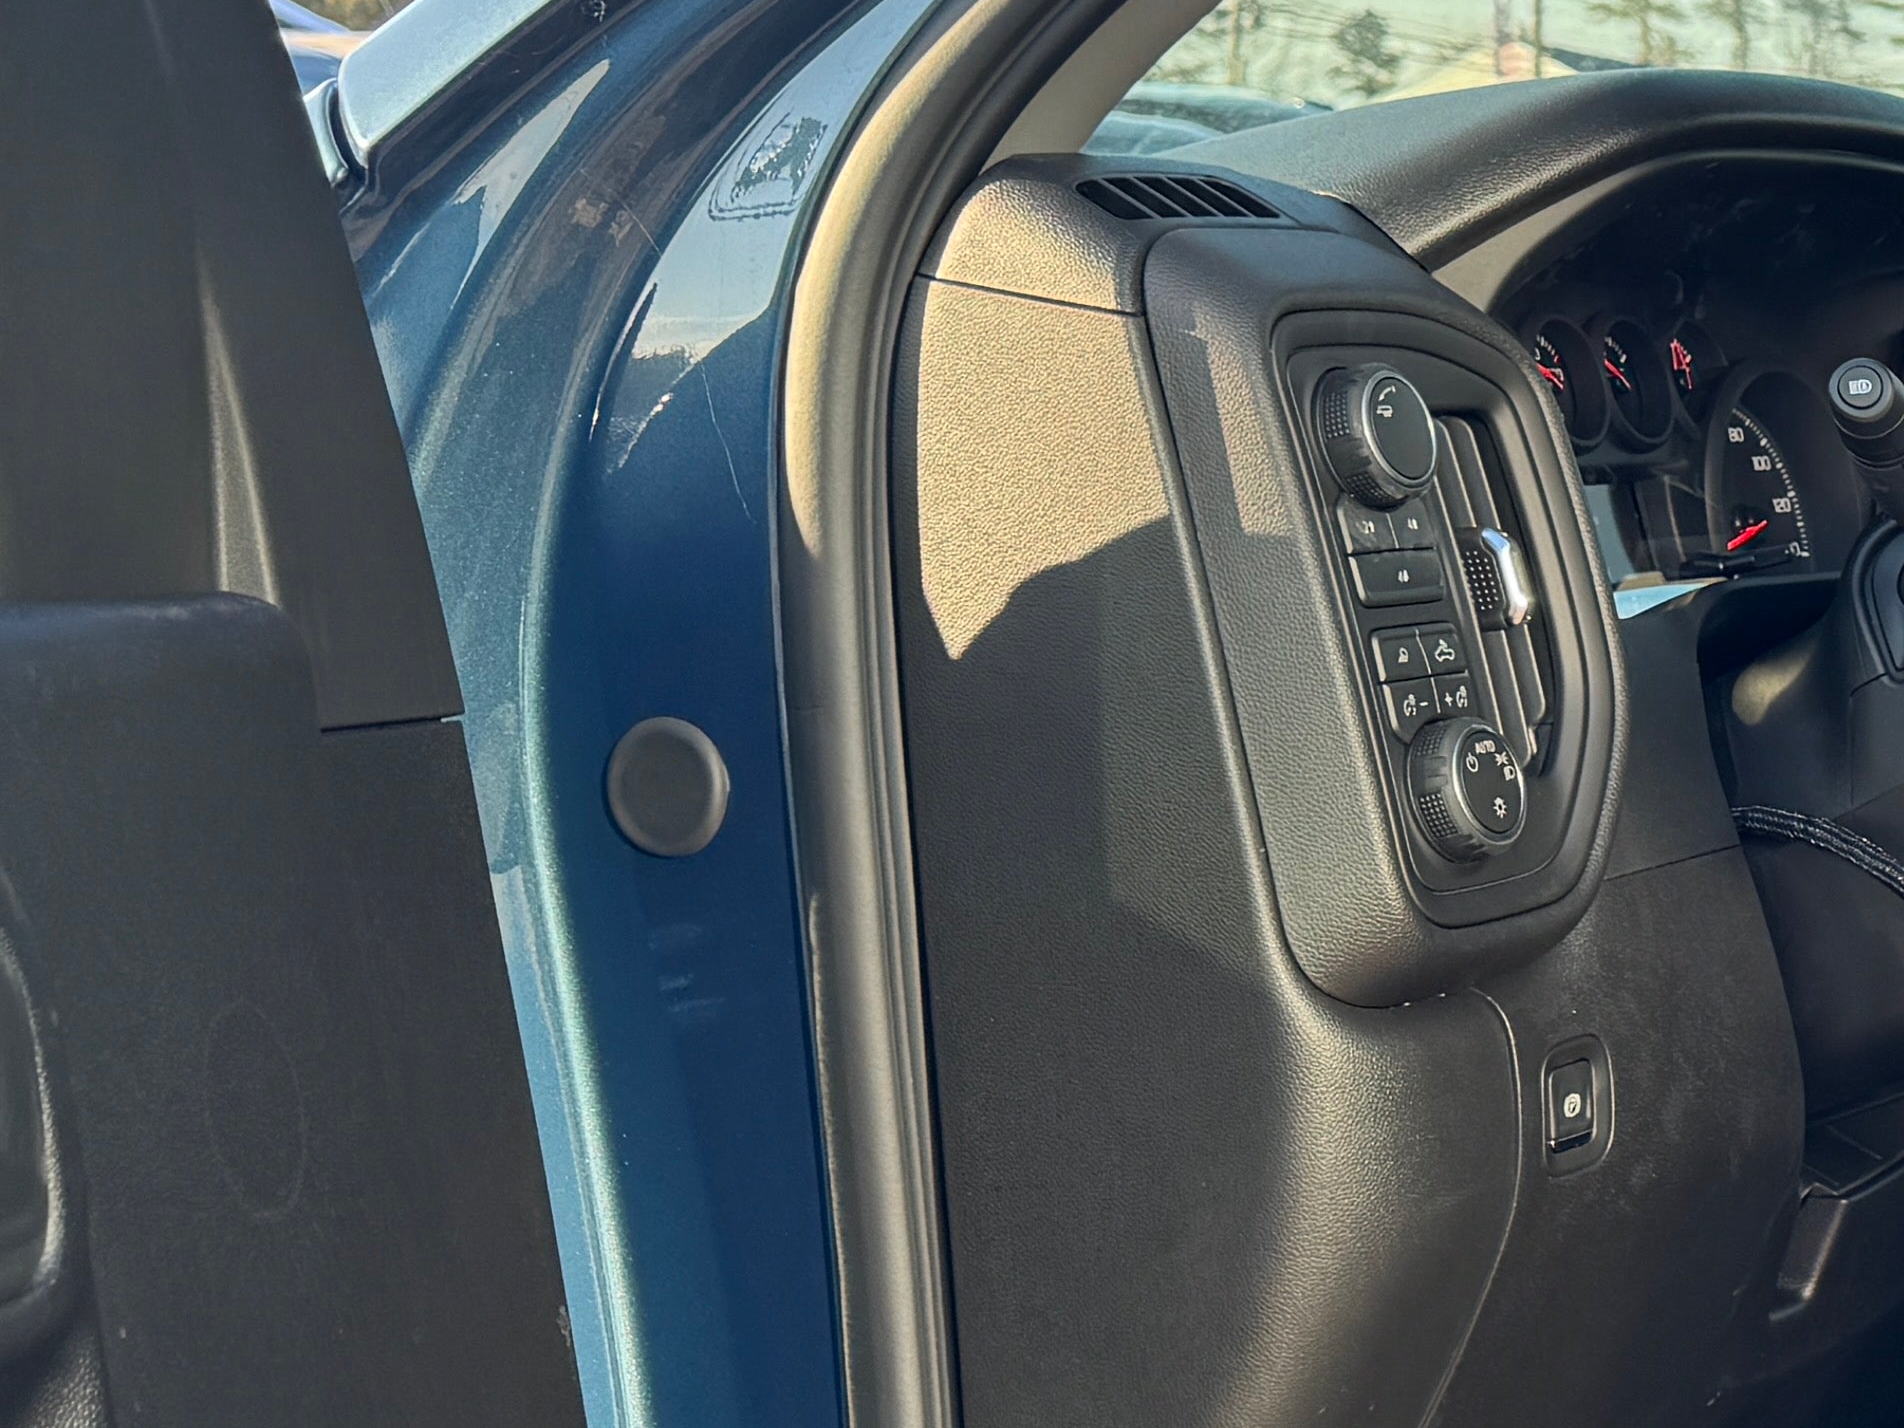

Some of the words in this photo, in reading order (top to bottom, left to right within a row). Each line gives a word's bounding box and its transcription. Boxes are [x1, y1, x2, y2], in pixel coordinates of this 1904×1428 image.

[1727, 427, 1744, 443] 80
[1751, 455, 1772, 471] 100
[1772, 497, 1792, 513] 120
